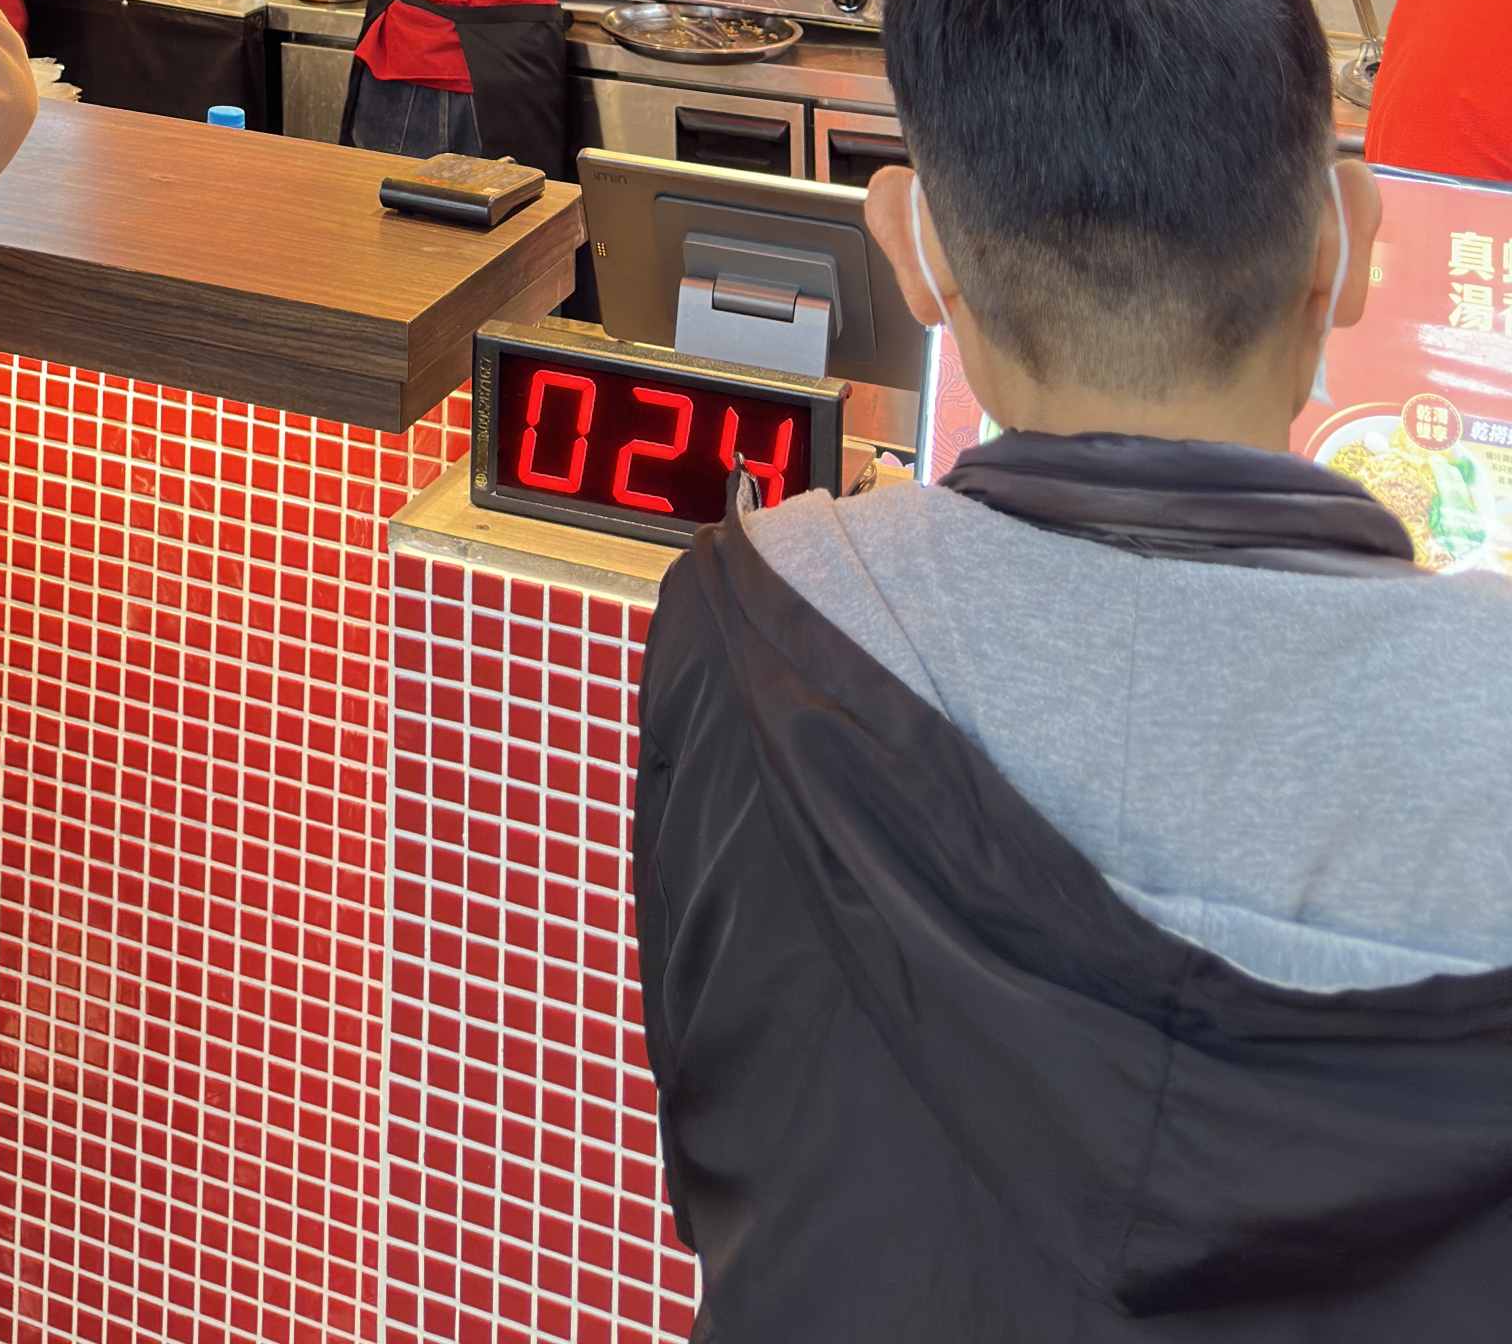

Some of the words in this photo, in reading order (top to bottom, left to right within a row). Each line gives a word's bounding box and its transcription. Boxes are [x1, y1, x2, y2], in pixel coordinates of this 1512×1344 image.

[1448, 231, 1512, 282] 真
[1448, 281, 1512, 334] 湯
[518, 369, 794, 512] 024
